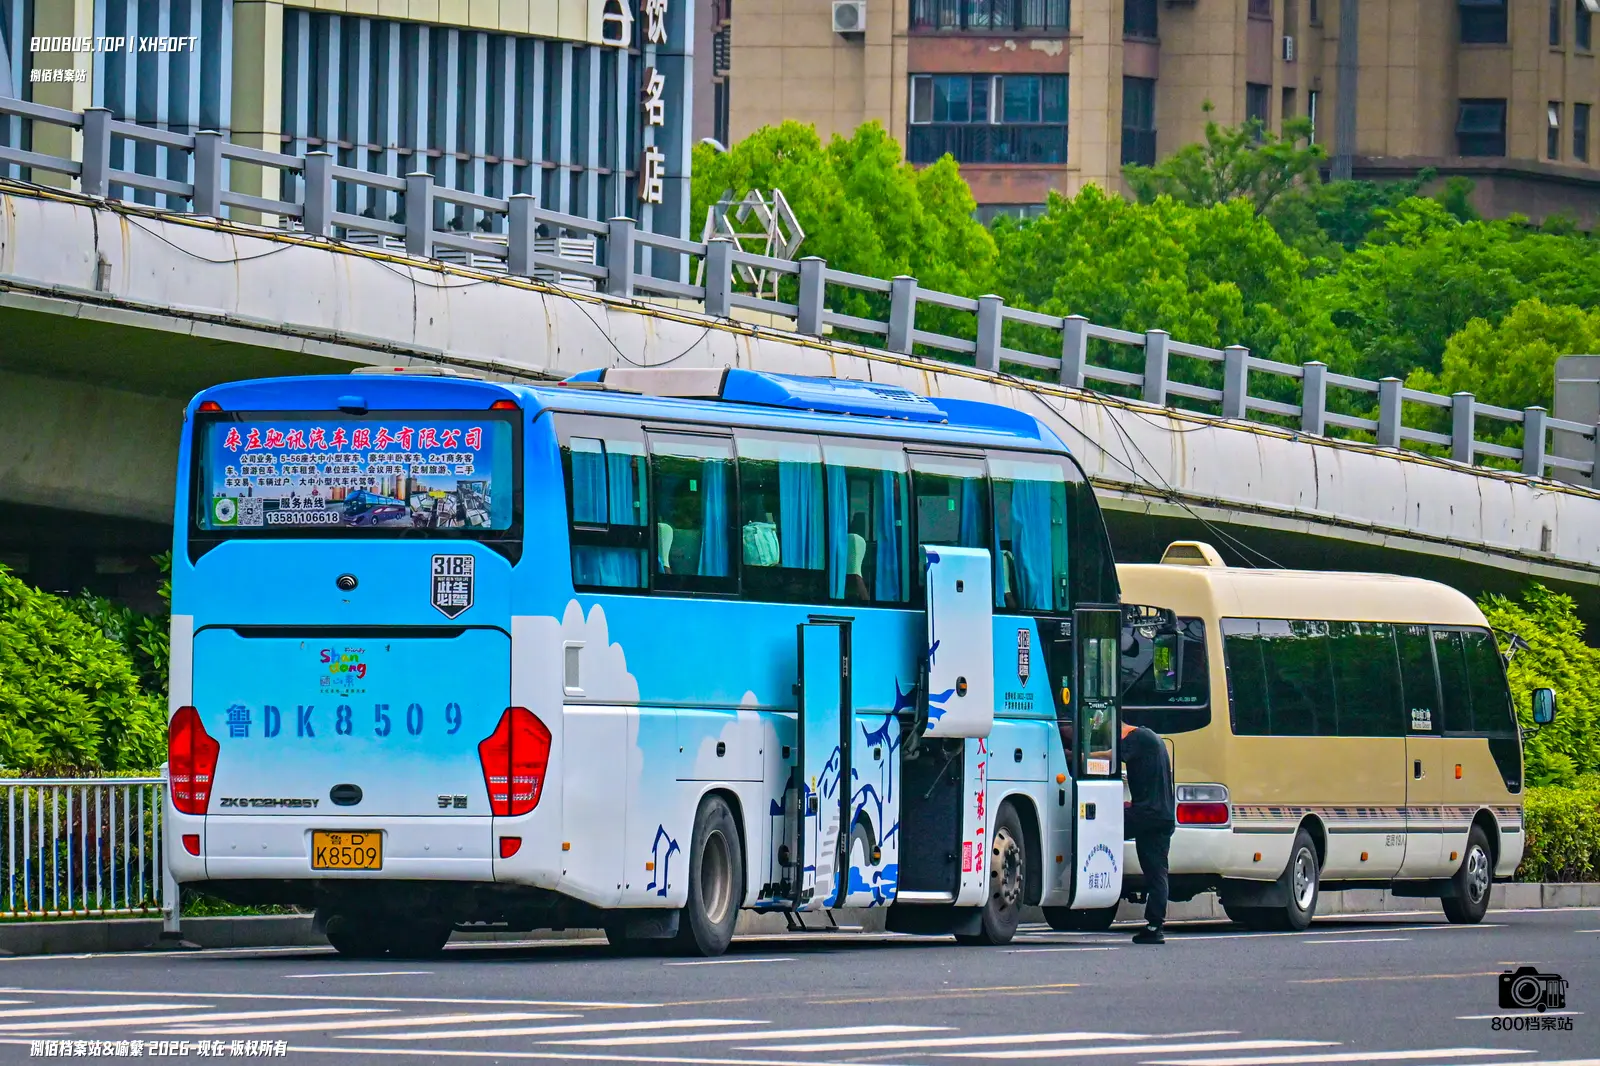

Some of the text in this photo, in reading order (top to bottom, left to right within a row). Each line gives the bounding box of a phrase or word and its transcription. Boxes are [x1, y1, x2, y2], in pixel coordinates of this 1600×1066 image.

[224, 426, 483, 452] 枣庄驰讯汽车服务有限公司
[280, 497, 325, 510] 服务热线
[266, 512, 340, 524] 13581106618
[434, 556, 464, 575] 318
[437, 581, 469, 594] 此生
[436, 593, 468, 607] 必驾
[319, 646, 360, 664] Shan
[329, 660, 367, 679] dong
[437, 794, 468, 809] 宇通
[316, 846, 377, 866] K8509
